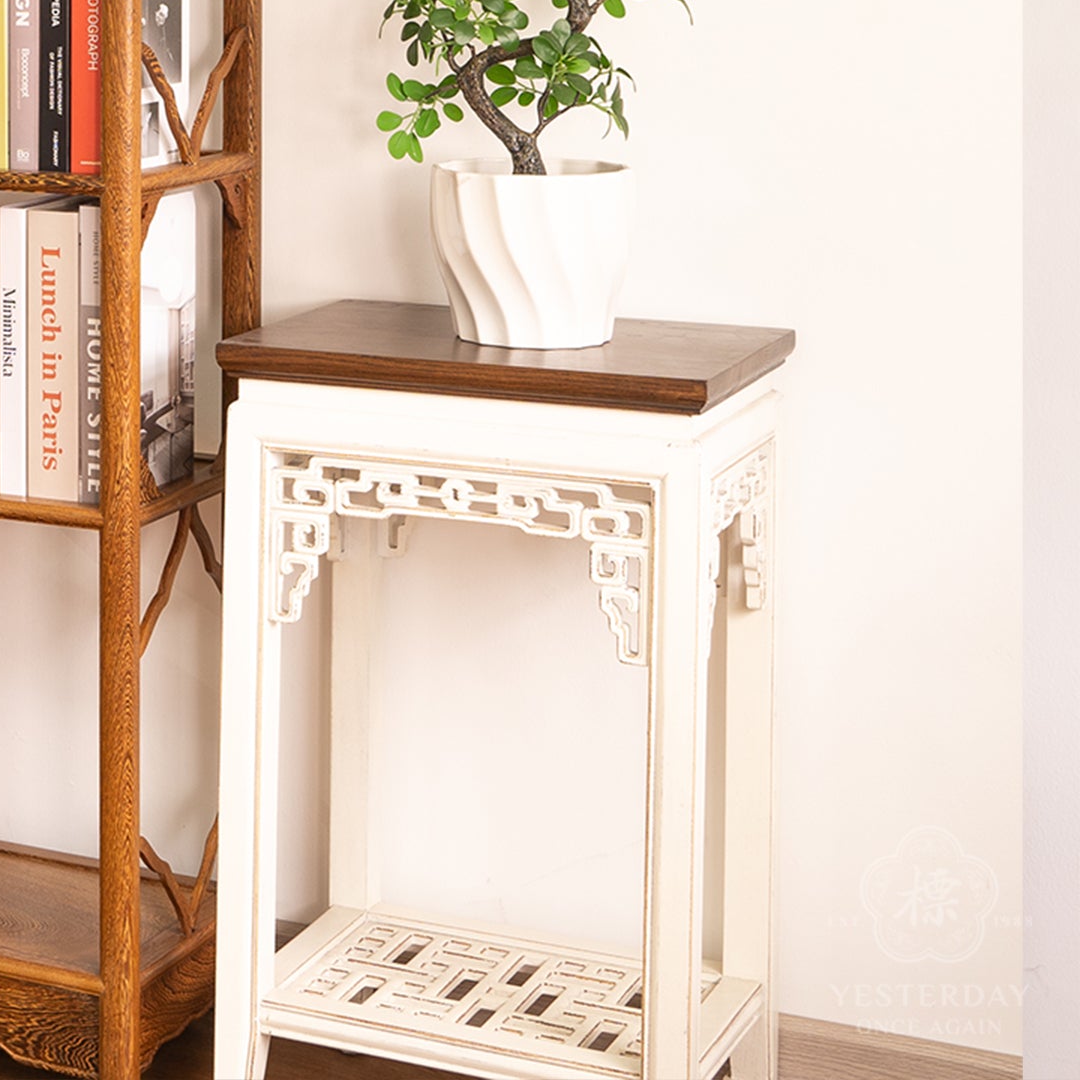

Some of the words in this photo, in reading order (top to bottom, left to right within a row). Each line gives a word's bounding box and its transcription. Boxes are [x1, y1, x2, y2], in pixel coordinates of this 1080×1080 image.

[2, 287, 17, 377] Minimalista
[41, 247, 62, 342] Lunch
[42, 352, 62, 380] in
[87, 318, 101, 400] HOME
[42, 392, 63, 471] Paris
[87, 412, 101, 492] STYLE
